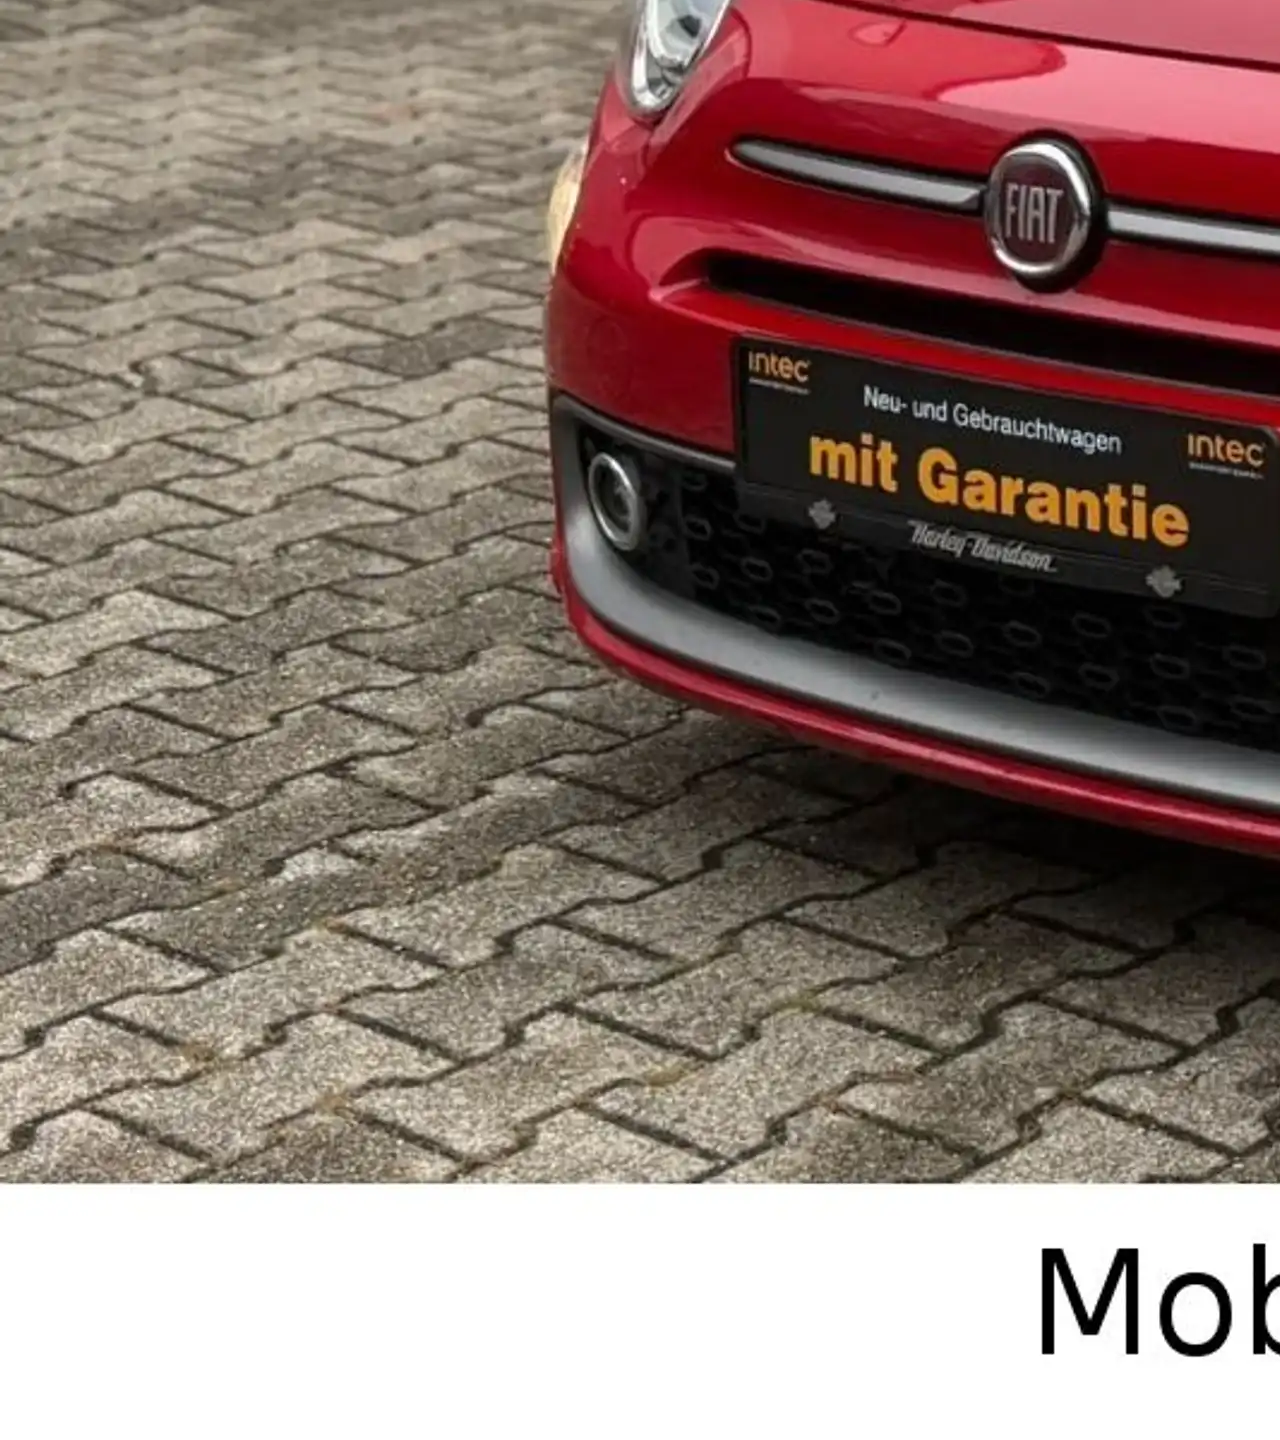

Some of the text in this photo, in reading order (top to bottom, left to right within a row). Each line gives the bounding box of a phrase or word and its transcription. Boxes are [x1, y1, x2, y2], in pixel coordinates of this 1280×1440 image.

[1005, 182, 1064, 244] FIAT
[863, 384, 1122, 456] Neu- und Gebrauchtwagen
[808, 431, 1191, 547] mit Garantie
